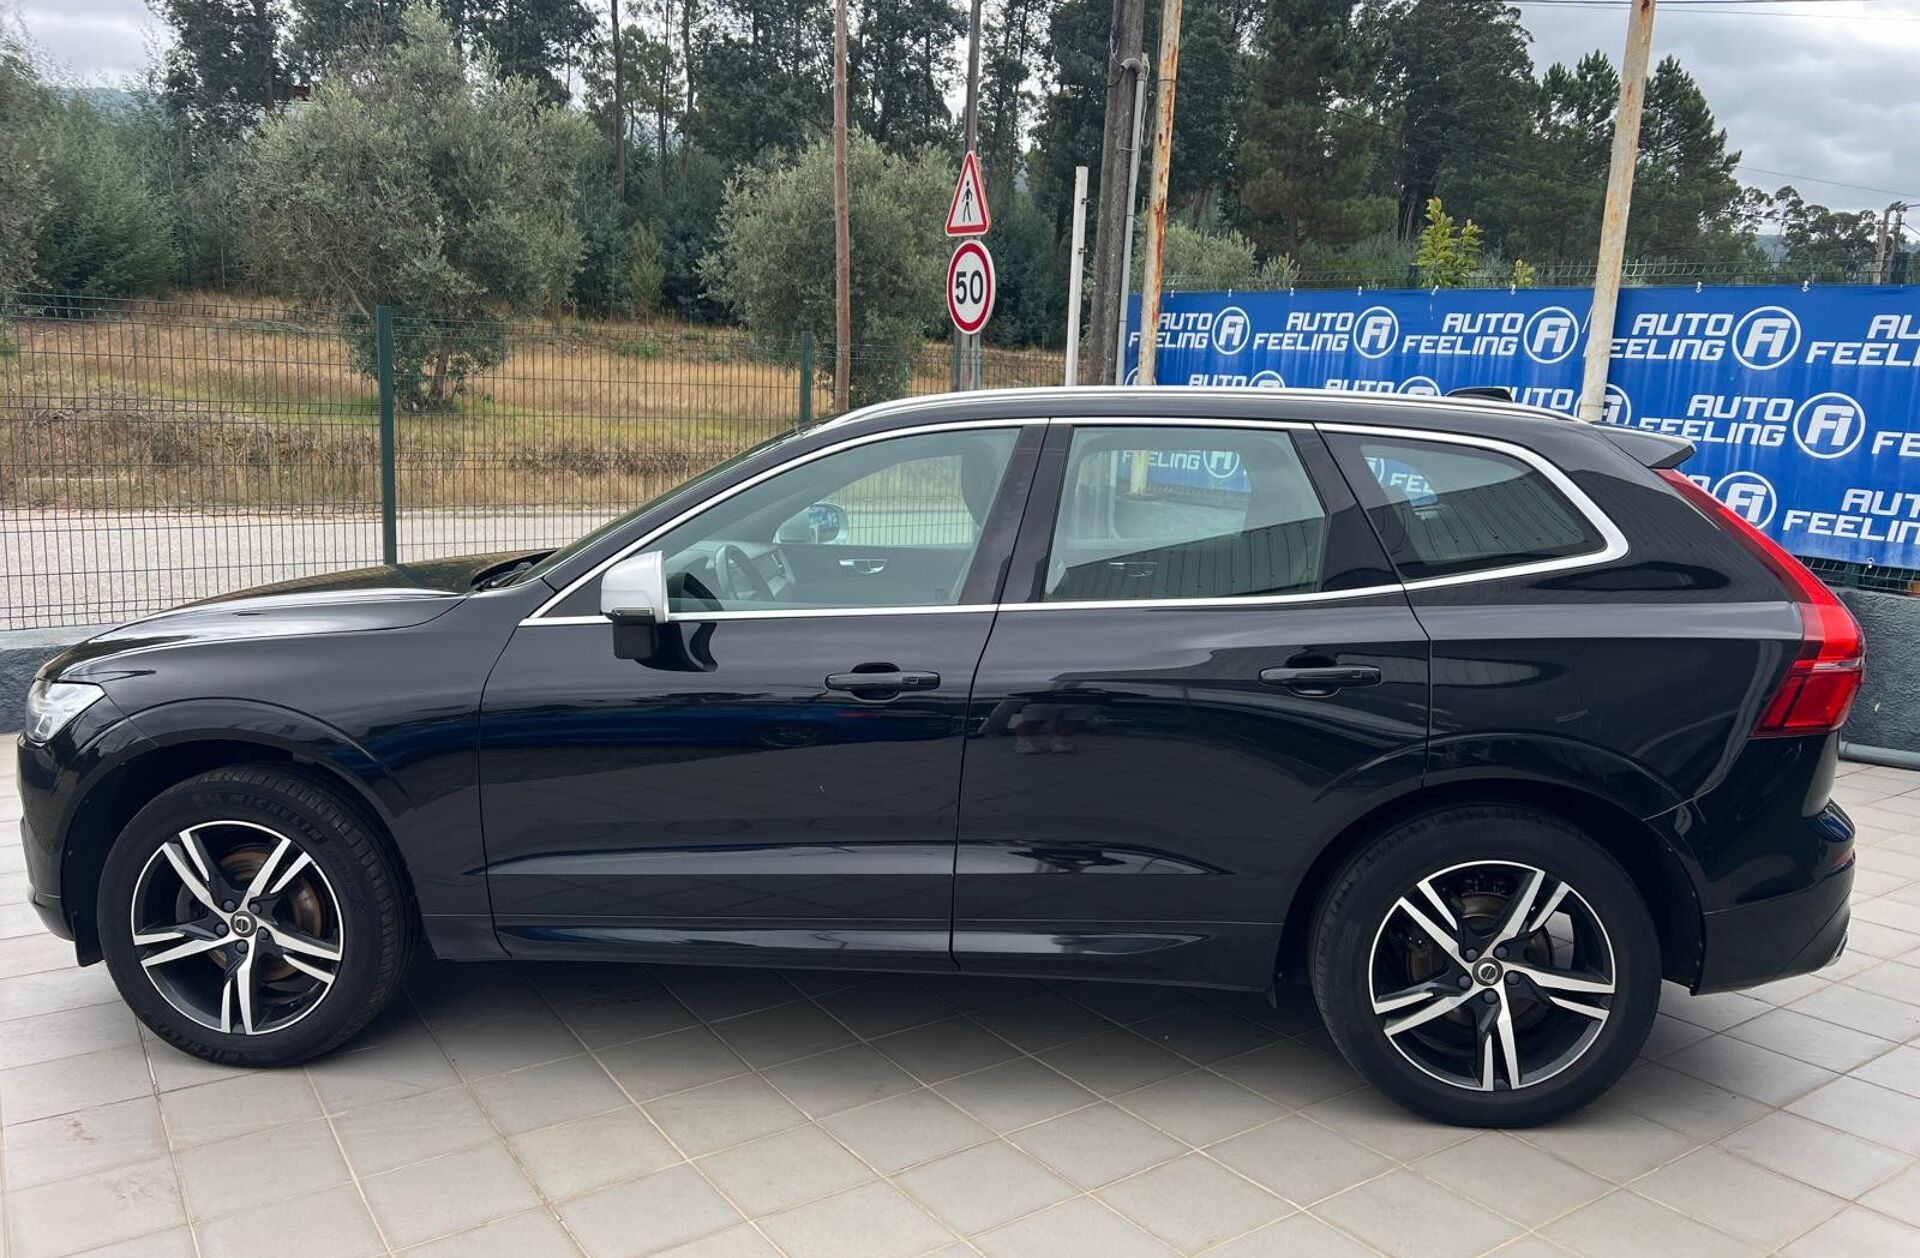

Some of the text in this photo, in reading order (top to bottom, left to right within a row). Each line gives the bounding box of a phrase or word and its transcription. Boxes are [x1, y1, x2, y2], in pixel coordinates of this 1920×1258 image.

[955, 270, 984, 304] 50
[1158, 312, 1213, 331] AUTO
[1286, 311, 1354, 332] AUTO
[1441, 312, 1525, 334] AUTO
[1632, 313, 1733, 337] AUTO
[1128, 332, 1208, 349] FELING
[1253, 332, 1349, 352] FEELING
[1401, 334, 1519, 356] FEELING
[1583, 337, 1726, 361] EELING
[1496, 386, 1574, 411] UTO
[1687, 394, 1794, 422] AUTO
[1639, 417, 1786, 447] FEELING
[1122, 450, 1201, 470] FELING
